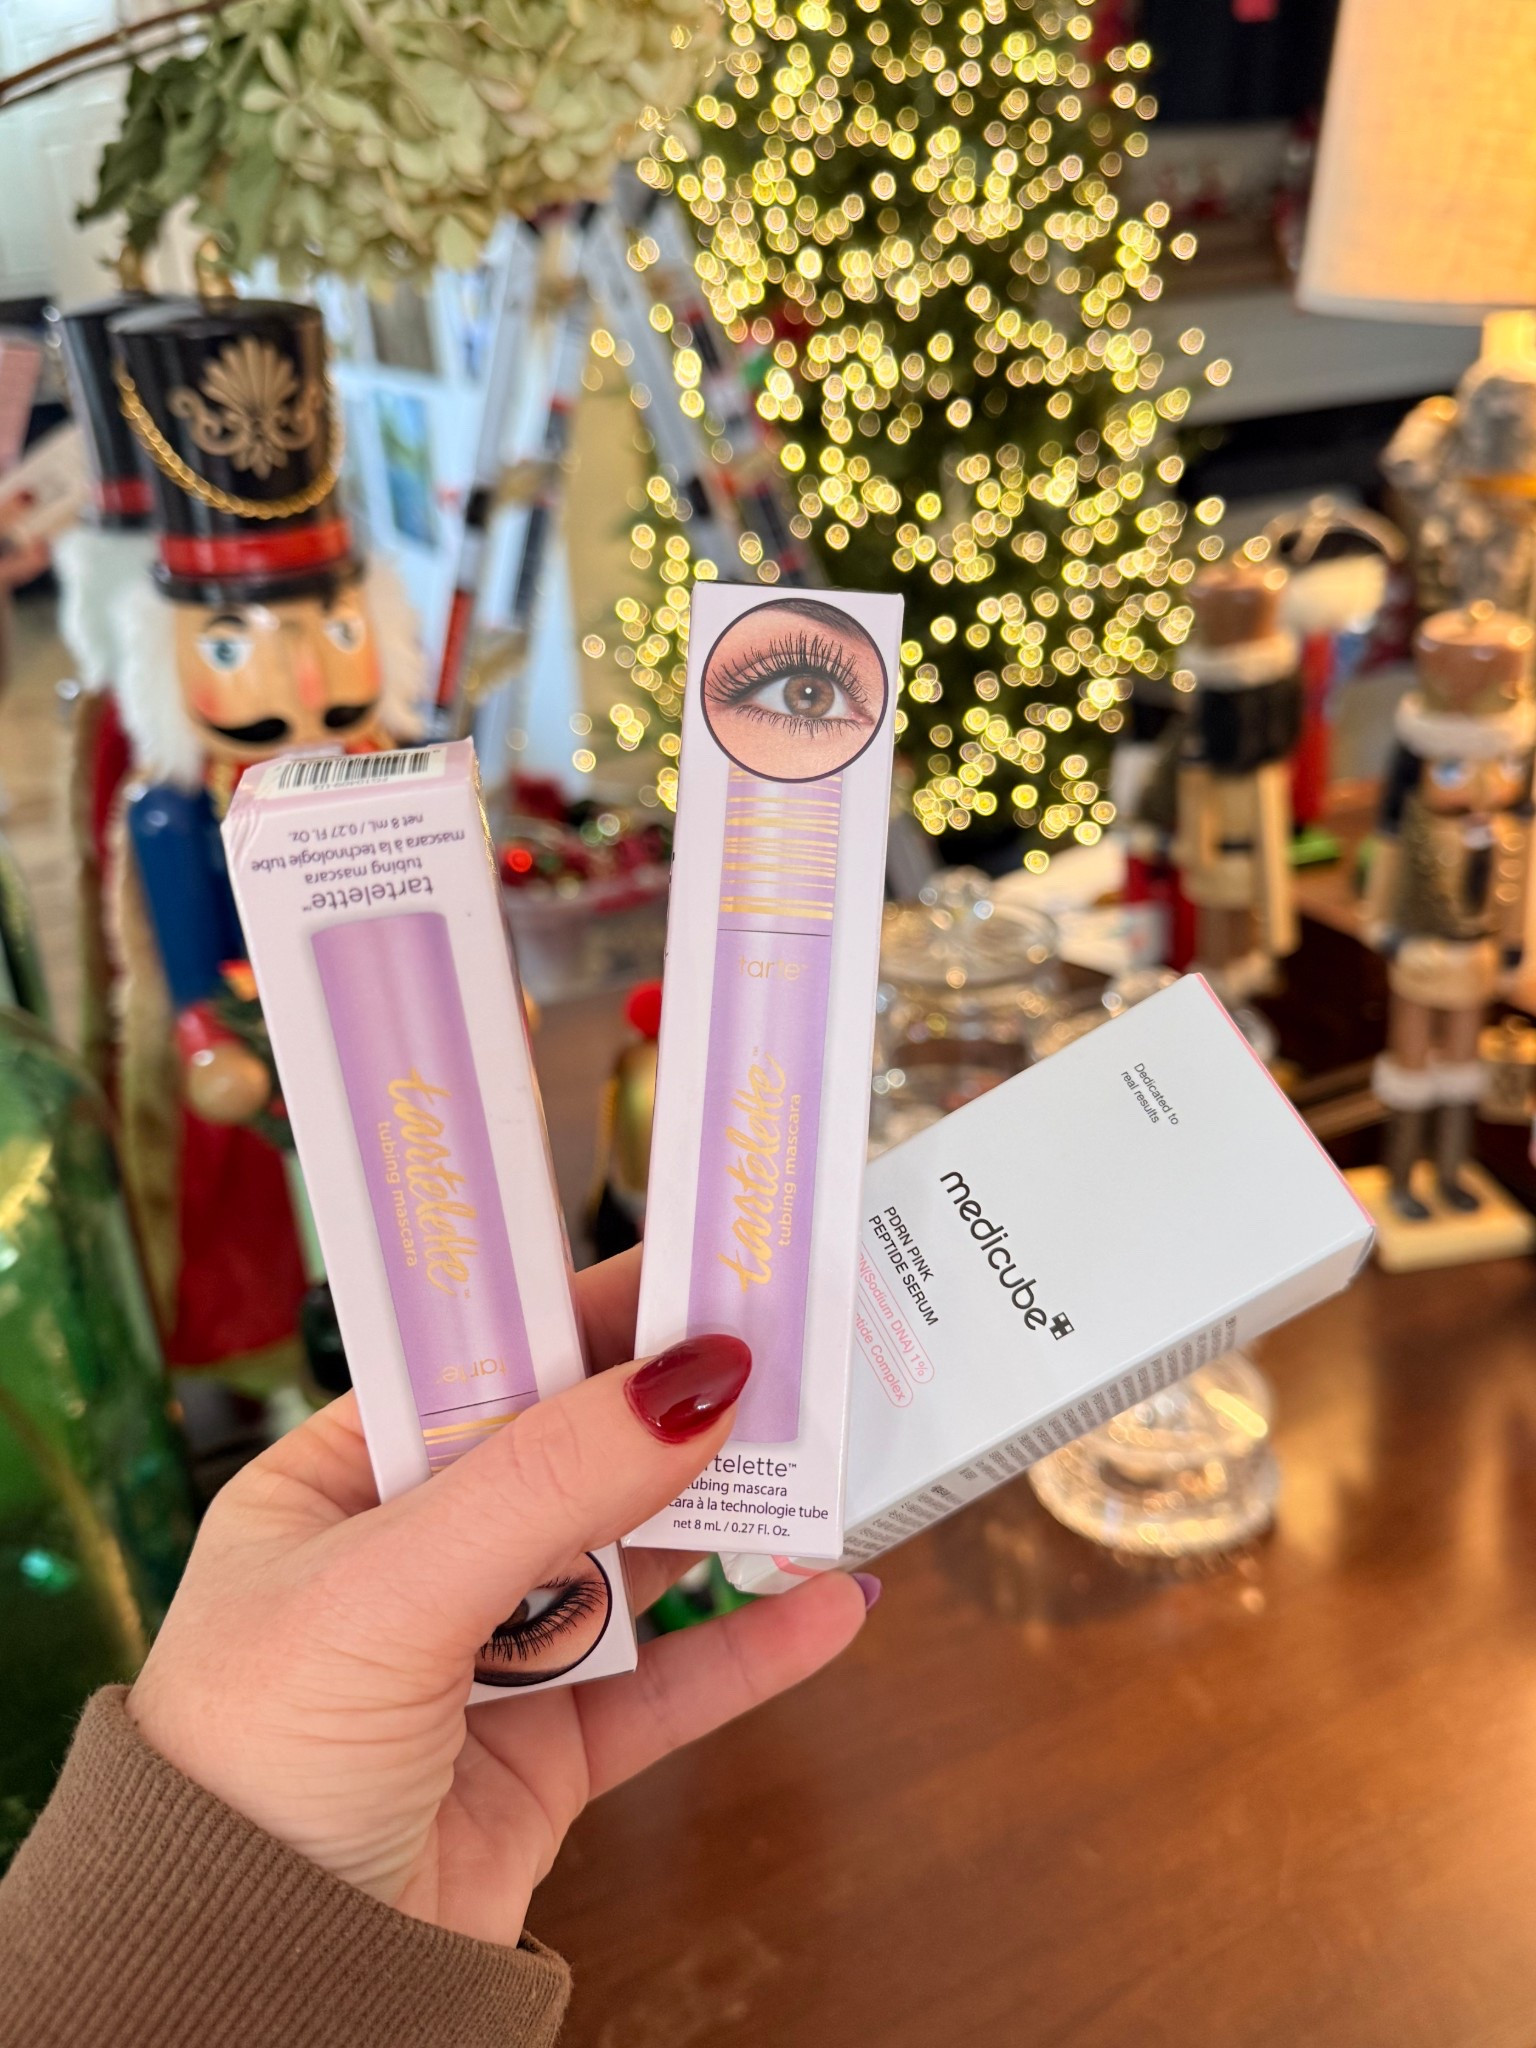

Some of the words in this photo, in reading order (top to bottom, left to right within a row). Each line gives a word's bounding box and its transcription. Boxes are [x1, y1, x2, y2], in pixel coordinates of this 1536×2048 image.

[369, 820, 389, 832] mL
[392, 819, 400, 829] 8
[403, 814, 423, 825] net
[289, 830, 310, 843] Oz.
[331, 823, 358, 839] 0.27
[406, 830, 465, 848] mascara
[290, 842, 376, 866] technologie
[379, 839, 392, 852] la
[395, 838, 403, 850] à
[251, 857, 286, 872] tube
[372, 858, 423, 875] tubing
[304, 867, 367, 885] mascara
[1121, 1071, 1139, 1090] real
[1134, 1090, 1160, 1123] results
[1134, 1063, 1173, 1113] Dedicated
[1168, 1113, 1179, 1125] to
[785, 1094, 801, 1175] mascara
[378, 1122, 401, 1184] tubing
[392, 1190, 418, 1267] mascara
[778, 1182, 797, 1247] tubing
[884, 1206, 913, 1246] PDRN
[907, 1242, 934, 1282] PINK
[940, 1171, 1047, 1331] medicube
[869, 1215, 909, 1274] PEPTIDE
[903, 1273, 939, 1326] SERUM
[891, 1319, 915, 1354] DNA)
[910, 1354, 929, 1377] 1%
[871, 1344, 906, 1402] Complex
[687, 1477, 729, 1495] ubing
[733, 1482, 788, 1497] mascara
[696, 1497, 704, 1510] à
[707, 1497, 717, 1511] la
[721, 1500, 796, 1519] technologie
[799, 1506, 829, 1520] tube
[673, 1519, 691, 1530] net
[694, 1519, 701, 1530] 8
[704, 1520, 721, 1532] mL
[731, 1522, 754, 1534] 0.27
[757, 1524, 770, 1535] Fl.
[772, 1525, 790, 1537] Oz.
